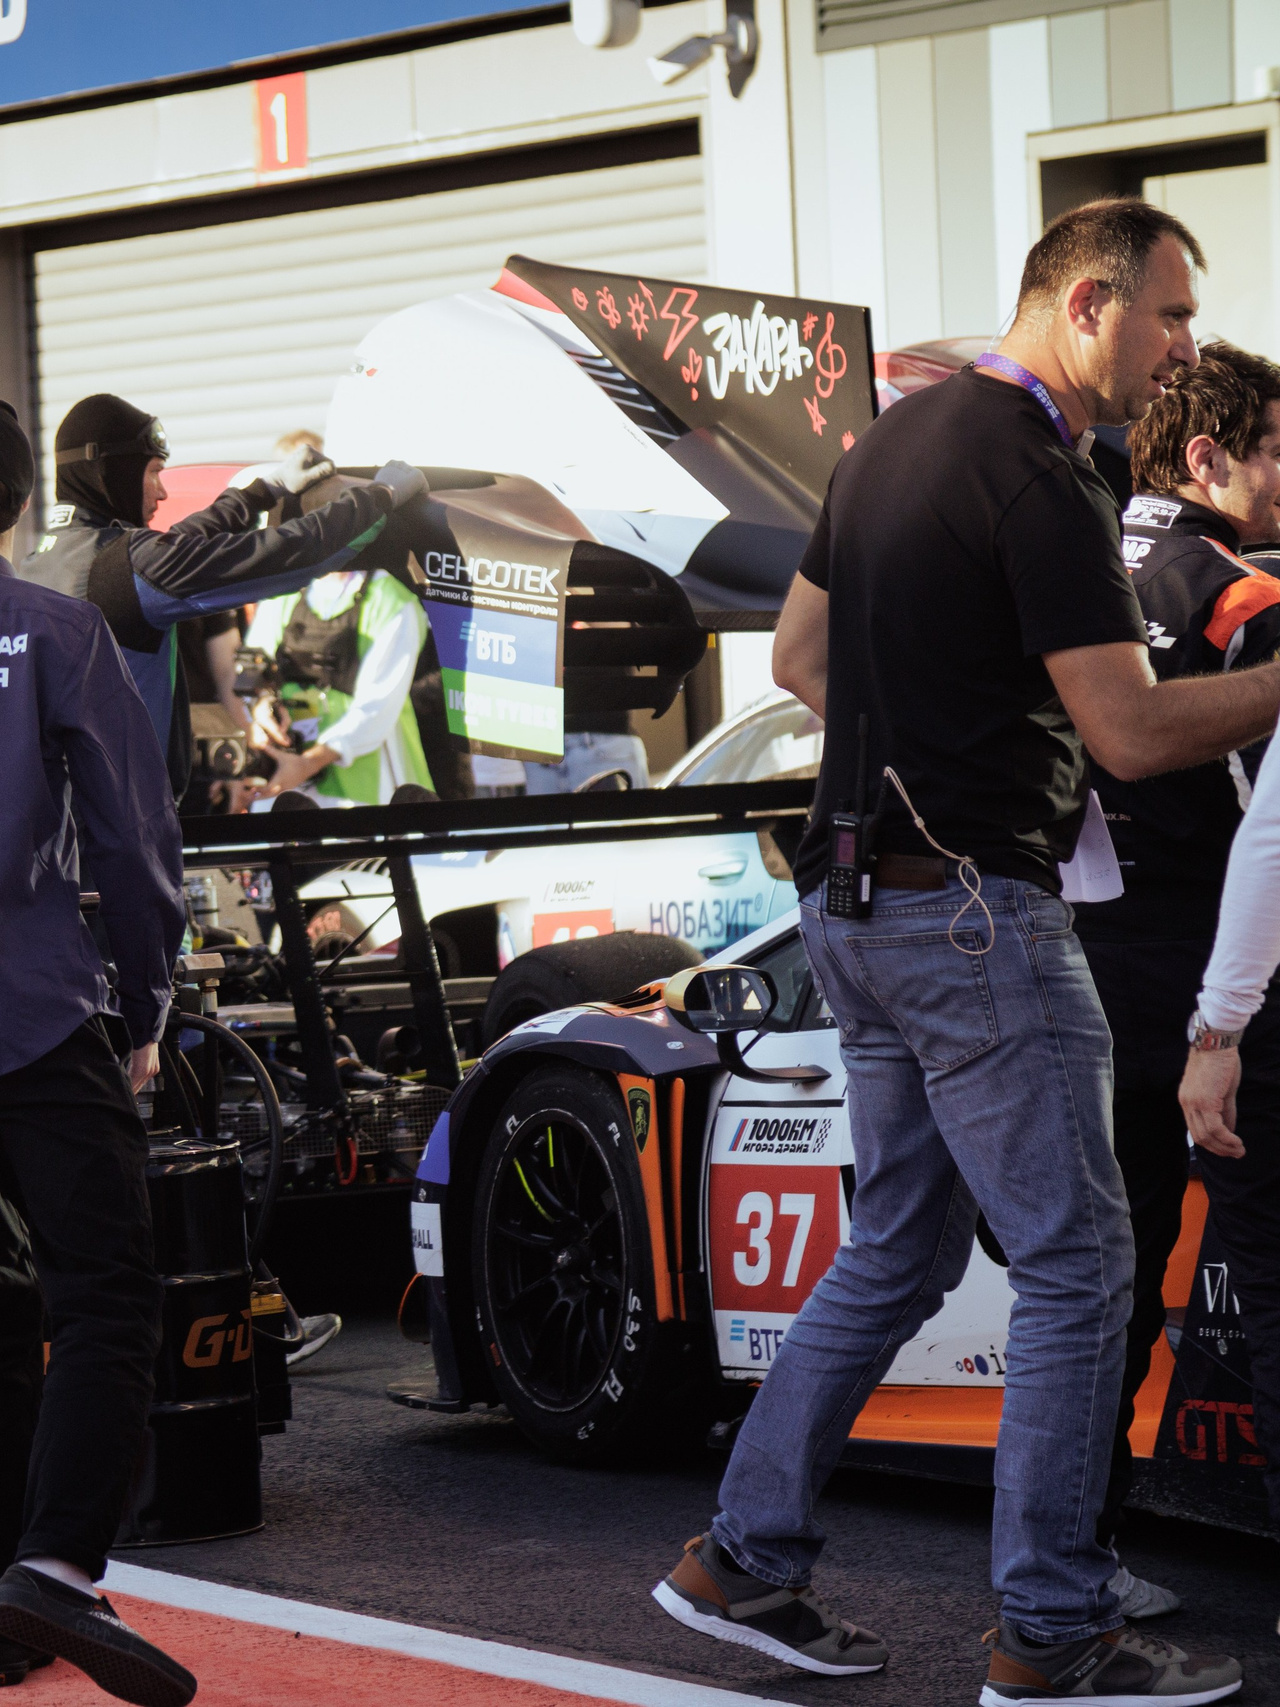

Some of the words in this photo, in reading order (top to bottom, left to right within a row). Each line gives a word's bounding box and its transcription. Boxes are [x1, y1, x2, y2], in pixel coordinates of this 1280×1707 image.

[270, 92, 288, 163] 1
[1122, 541, 1151, 562] MP
[425, 551, 560, 596] СЕНСОТЕК
[425, 587, 461, 600] датчики
[471, 595, 511, 609] системы
[511, 602, 558, 617] контроля
[476, 629, 517, 665] ВТБ
[449, 688, 492, 716] IKON
[649, 897, 754, 940] НОБАЗИТ
[748, 1118, 819, 1142] 1000КМ
[733, 1191, 816, 1287] 37
